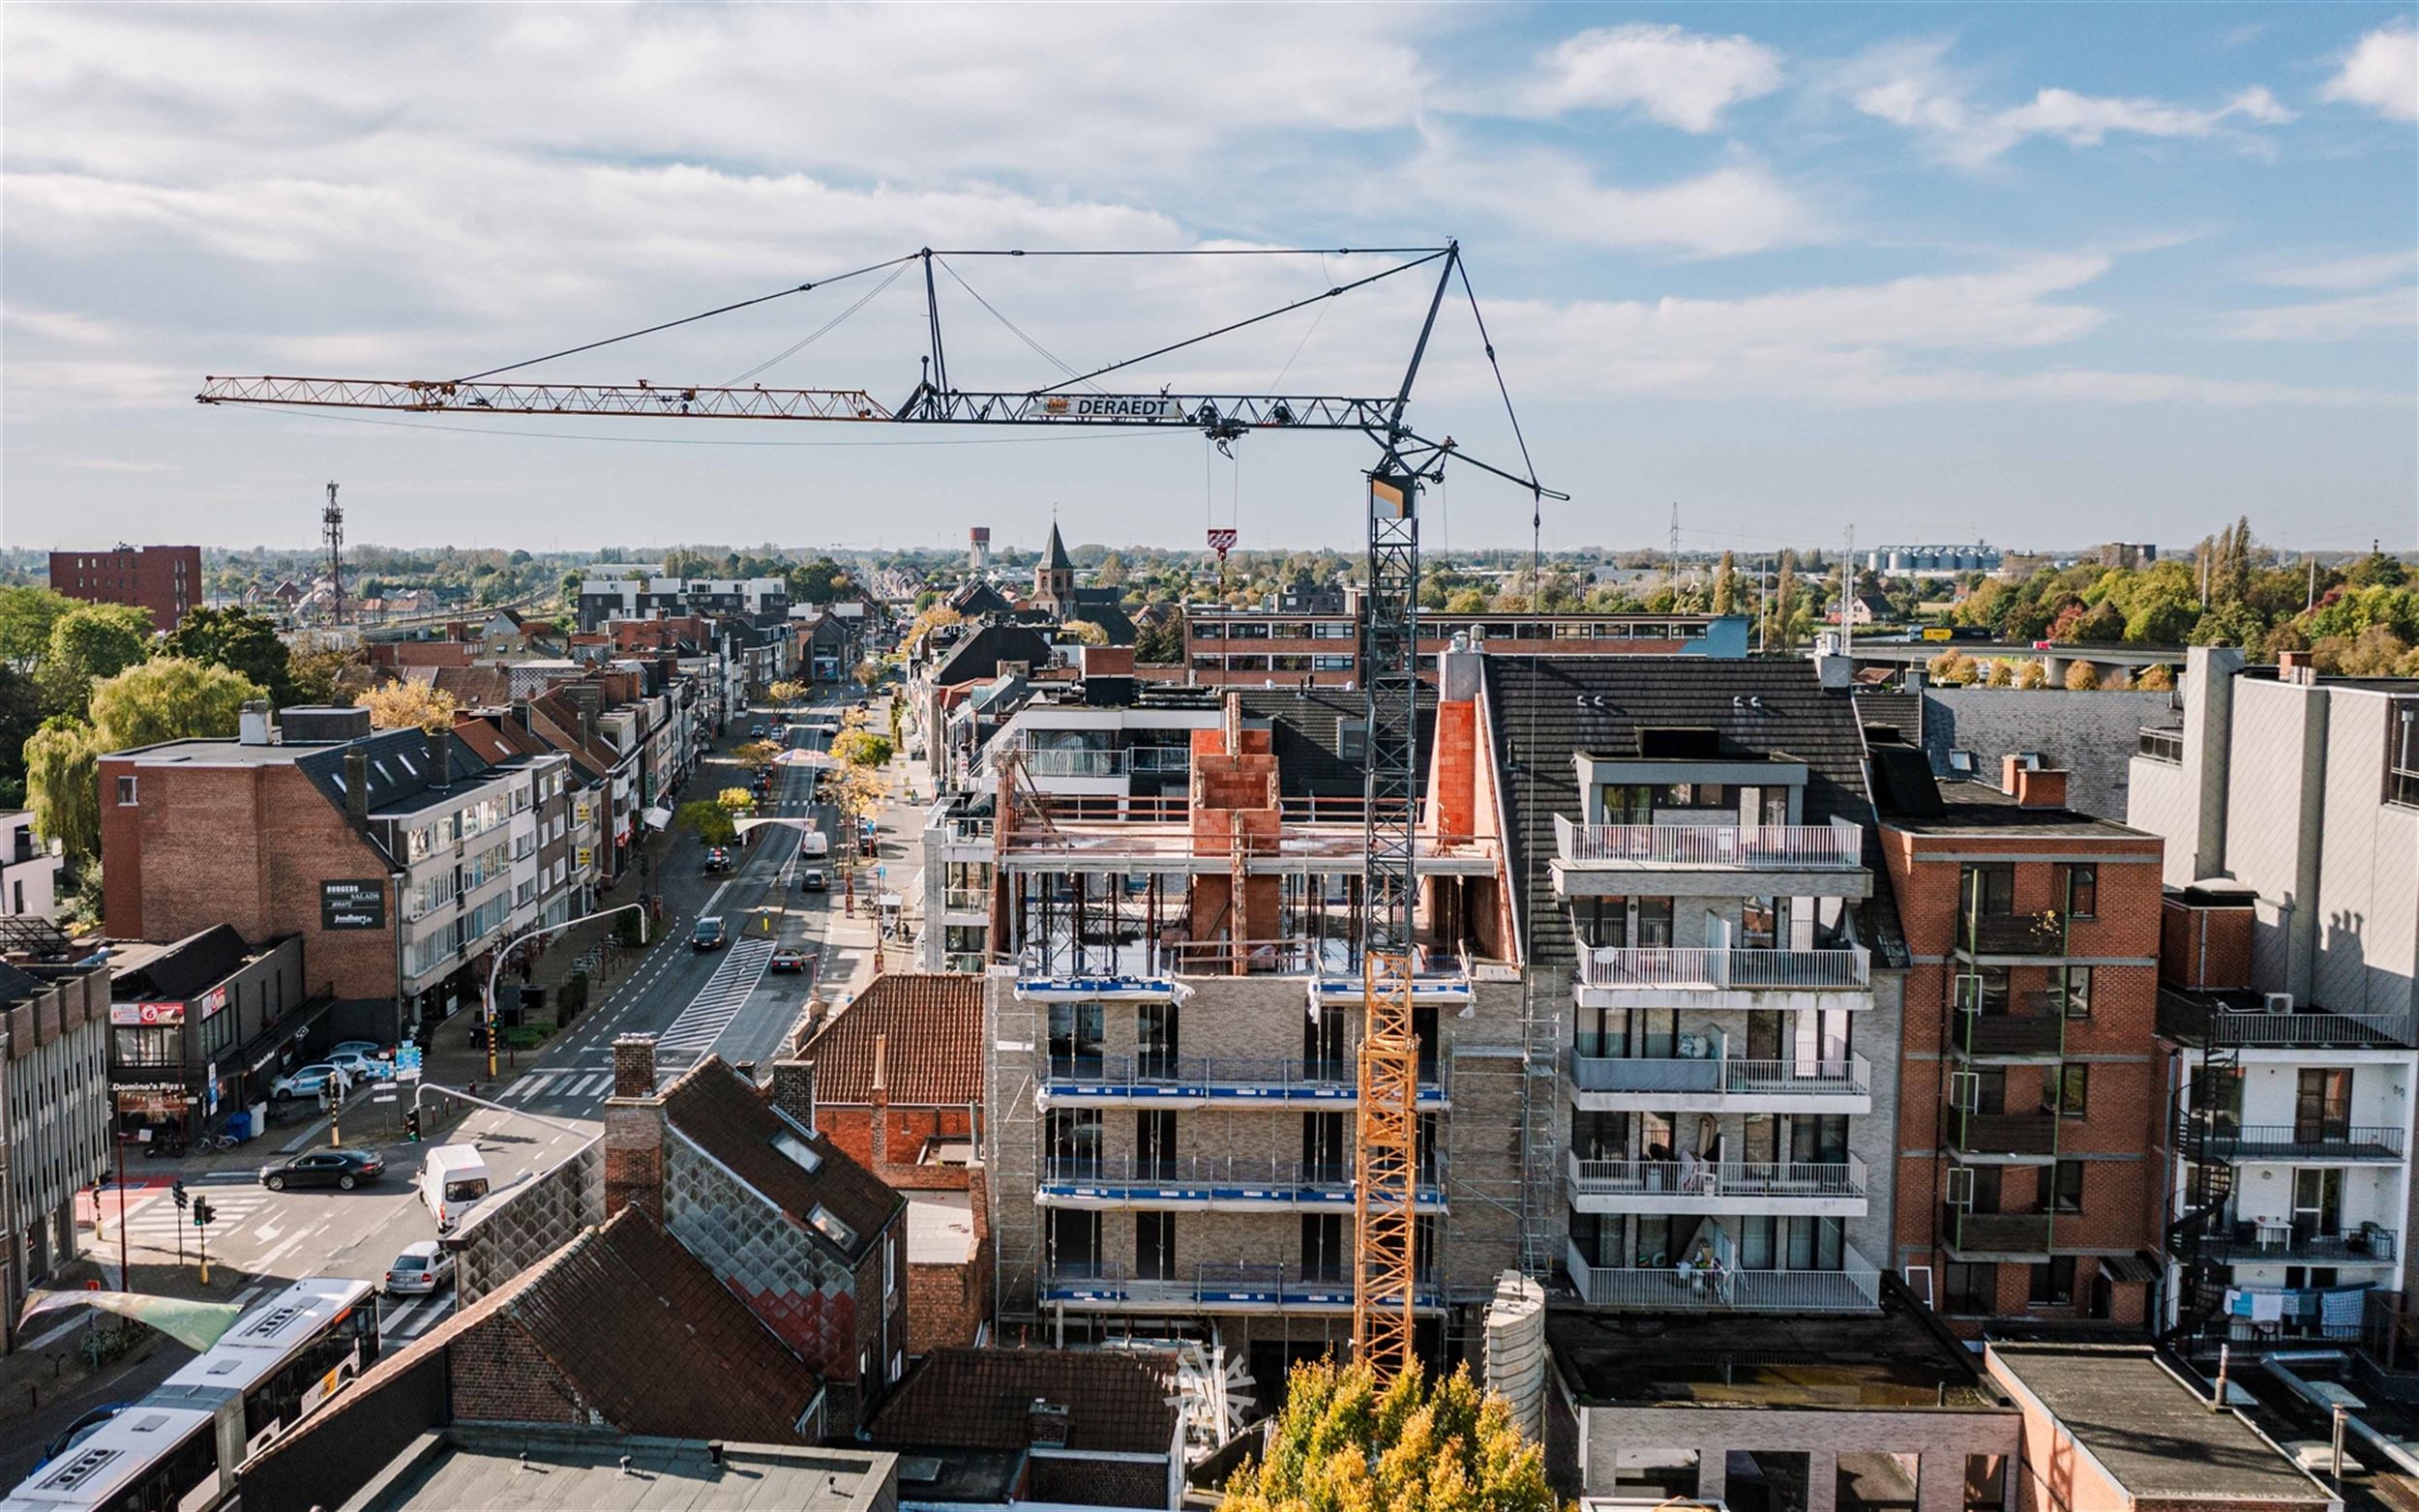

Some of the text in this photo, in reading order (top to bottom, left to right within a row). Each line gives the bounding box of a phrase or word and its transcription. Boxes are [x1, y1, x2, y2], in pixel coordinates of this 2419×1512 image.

[1078, 400, 1169, 415] DERAEDT
[326, 885, 359, 894] BURGERS
[112, 1082, 158, 1091] Domino's
